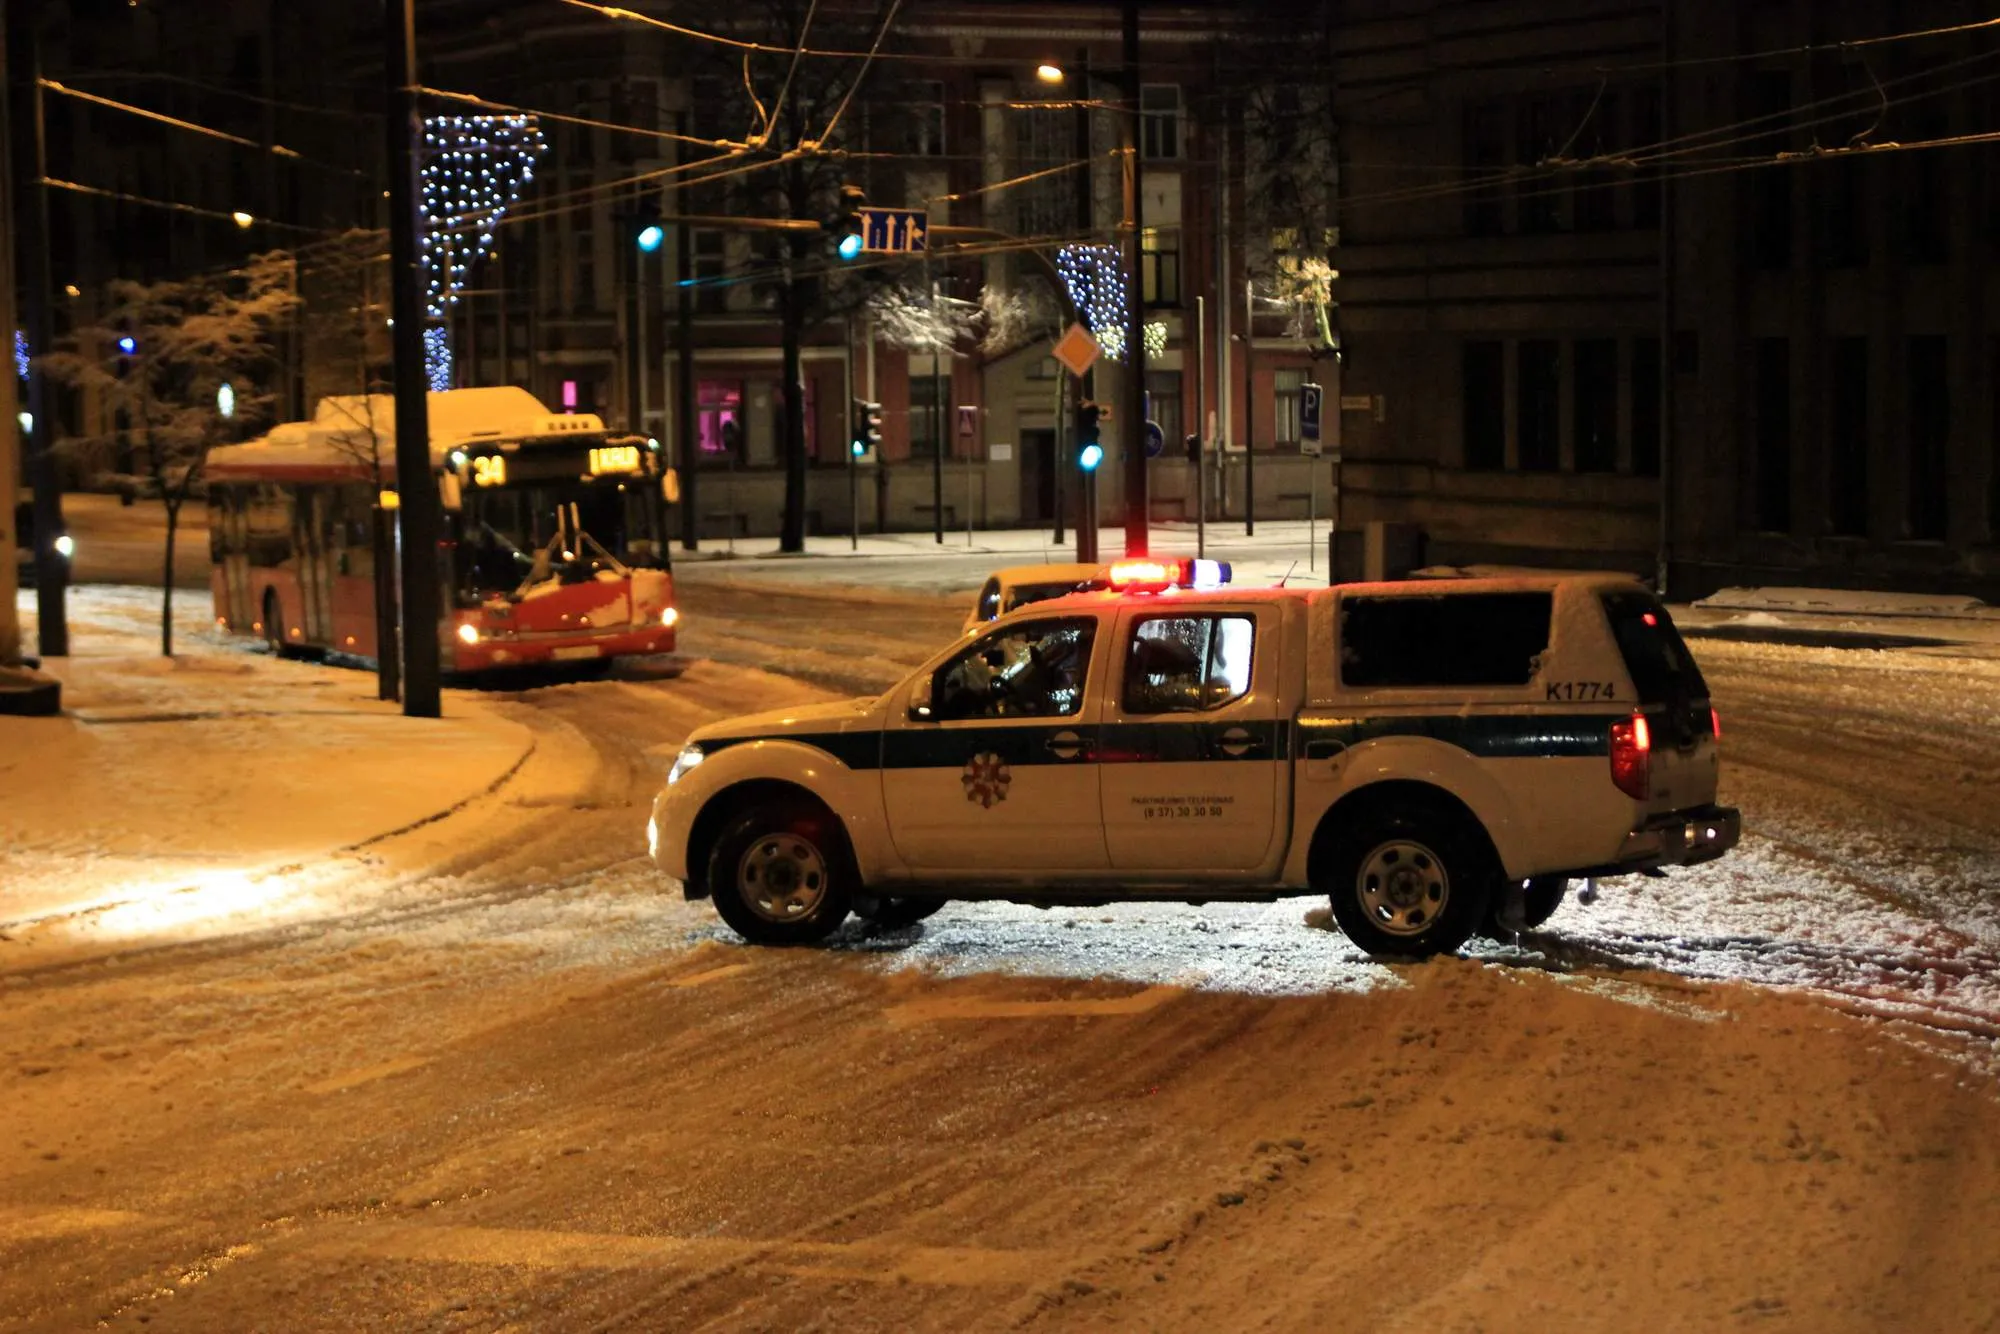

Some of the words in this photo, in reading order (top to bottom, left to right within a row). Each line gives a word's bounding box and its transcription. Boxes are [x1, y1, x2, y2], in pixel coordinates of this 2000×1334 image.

[1304, 389, 1317, 418] P
[473, 454, 506, 487] 34
[1546, 681, 1615, 700] K1774
[1158, 807, 1175, 819] 37)
